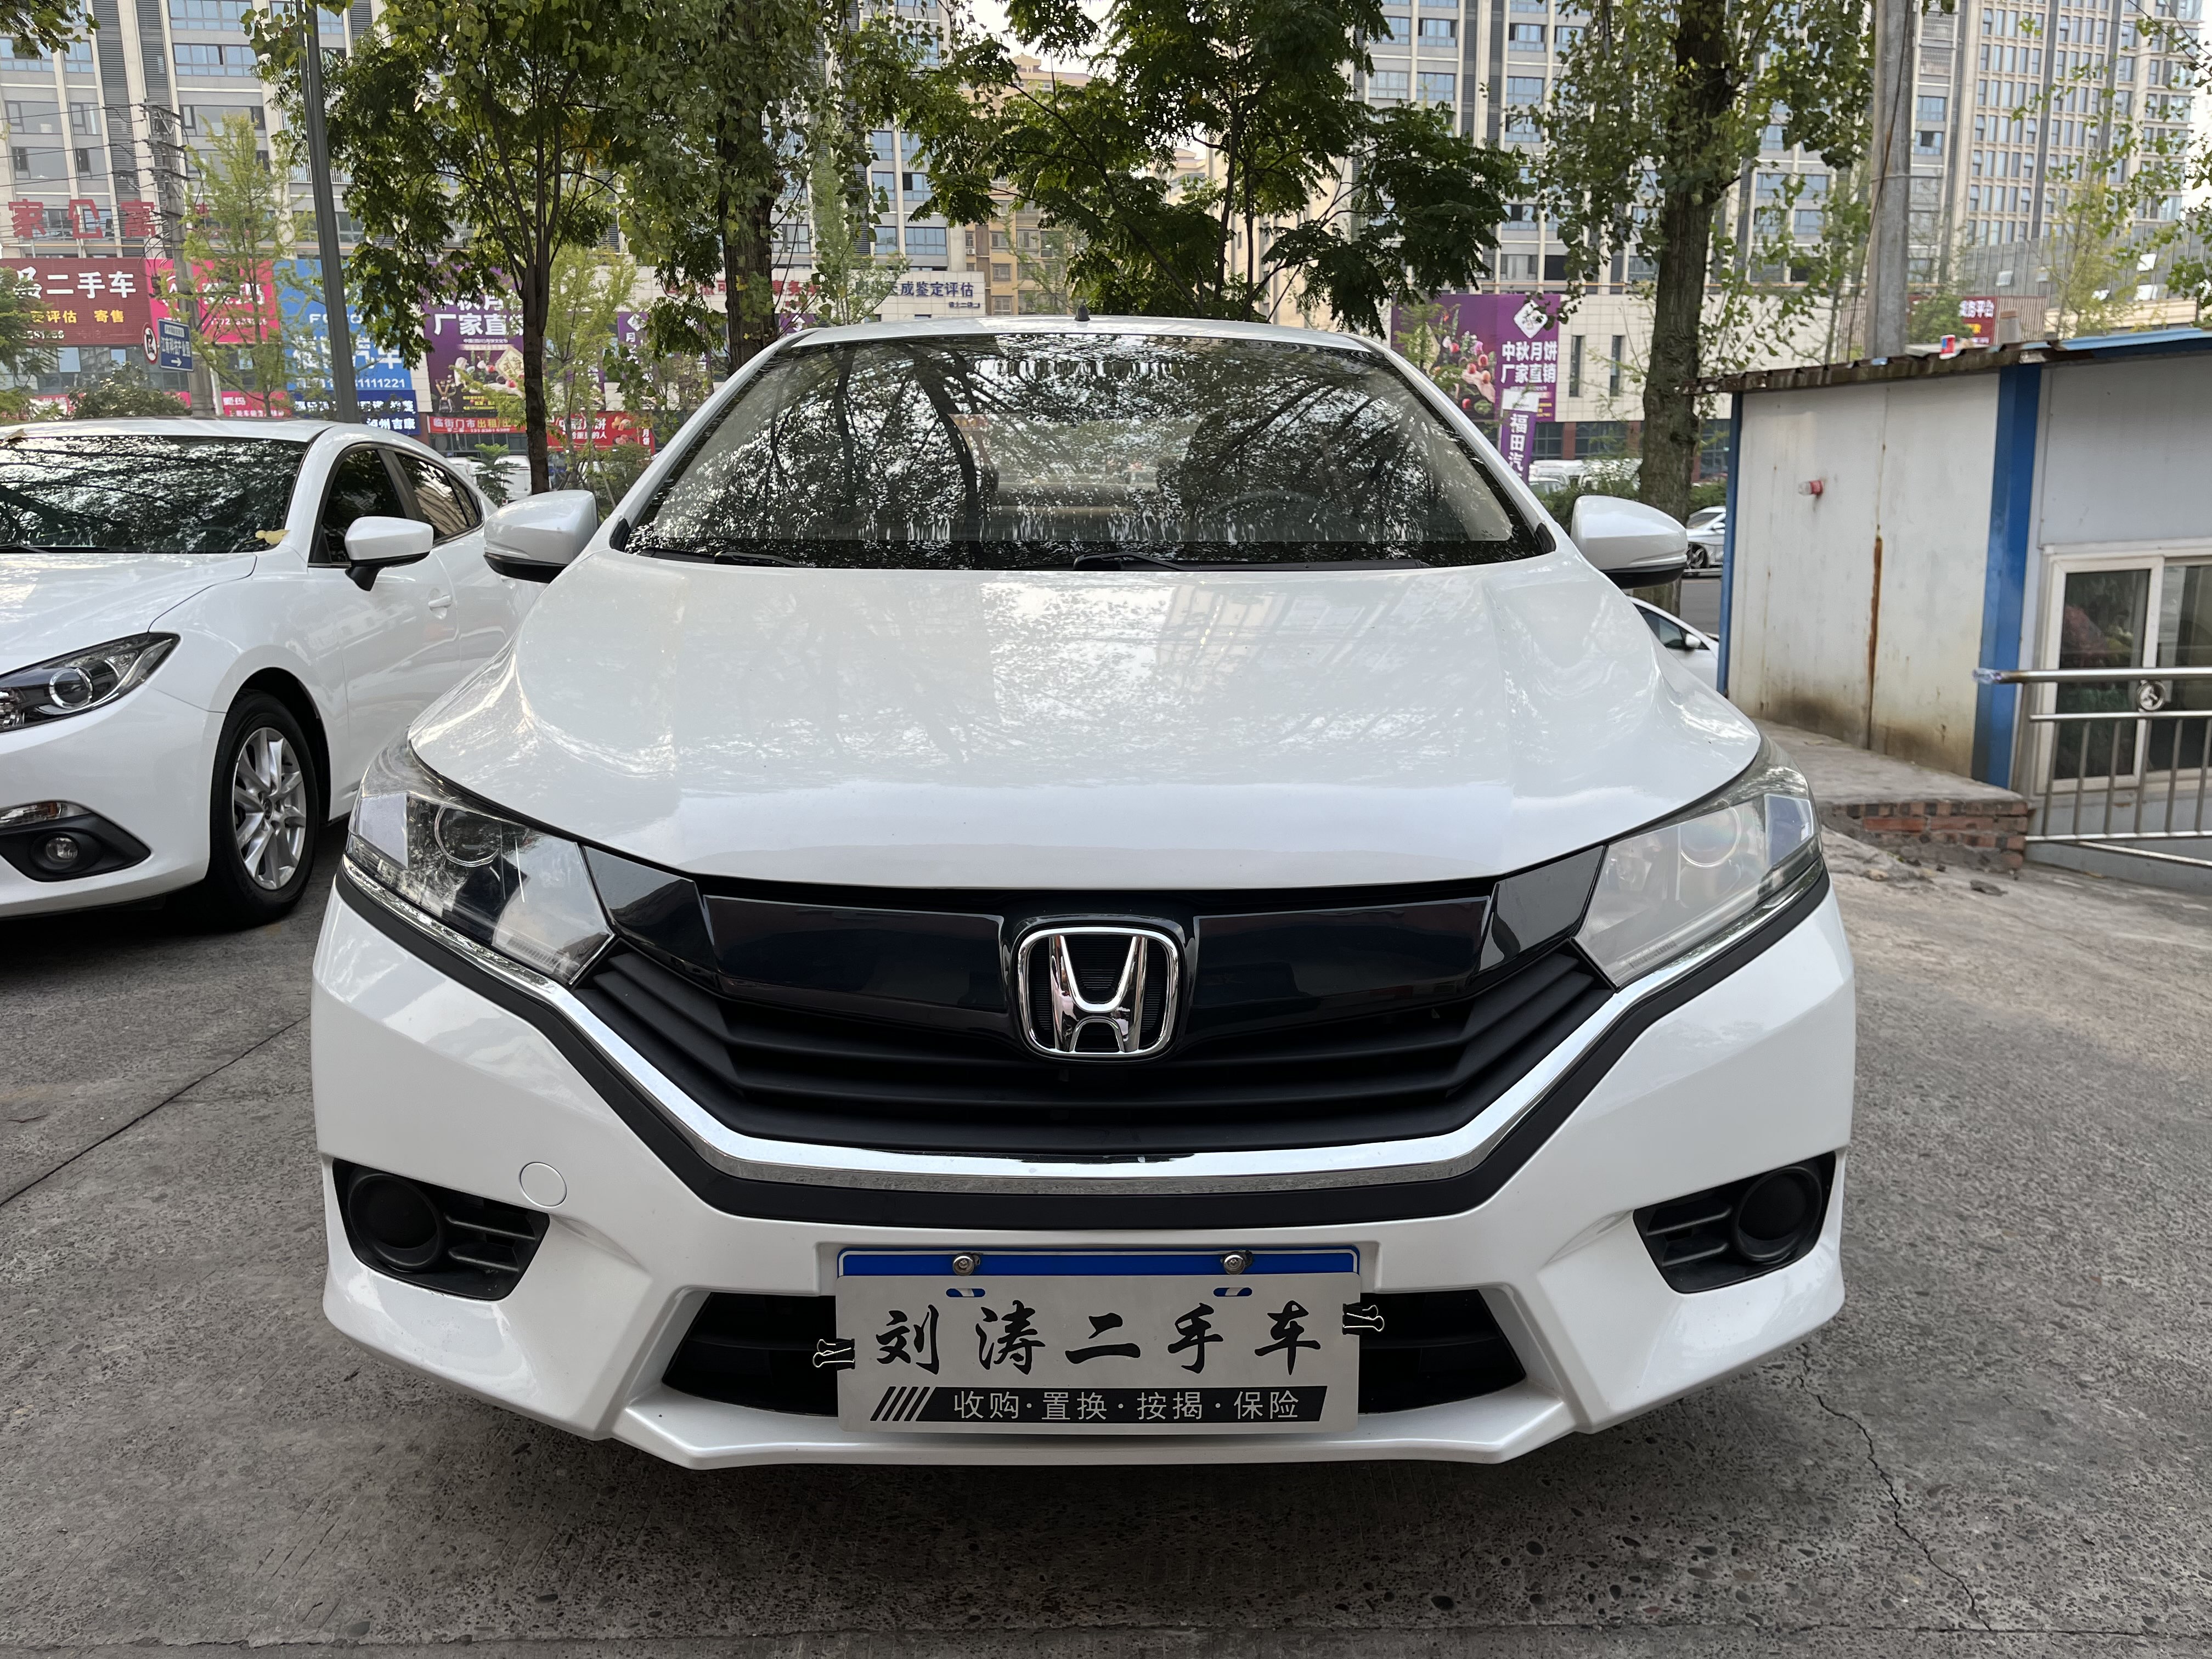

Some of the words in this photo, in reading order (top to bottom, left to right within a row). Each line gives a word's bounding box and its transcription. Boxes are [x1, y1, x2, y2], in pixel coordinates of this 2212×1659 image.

[94, 310, 125, 323] 寄售
[434, 313, 523, 336] 厂家直
[1502, 341, 1558, 362] 中秋月饼
[1500, 363, 1556, 383] 厂家直销
[1508, 414, 1528, 477] 福田汽
[876, 1300, 1321, 1375] 刘涛二手车
